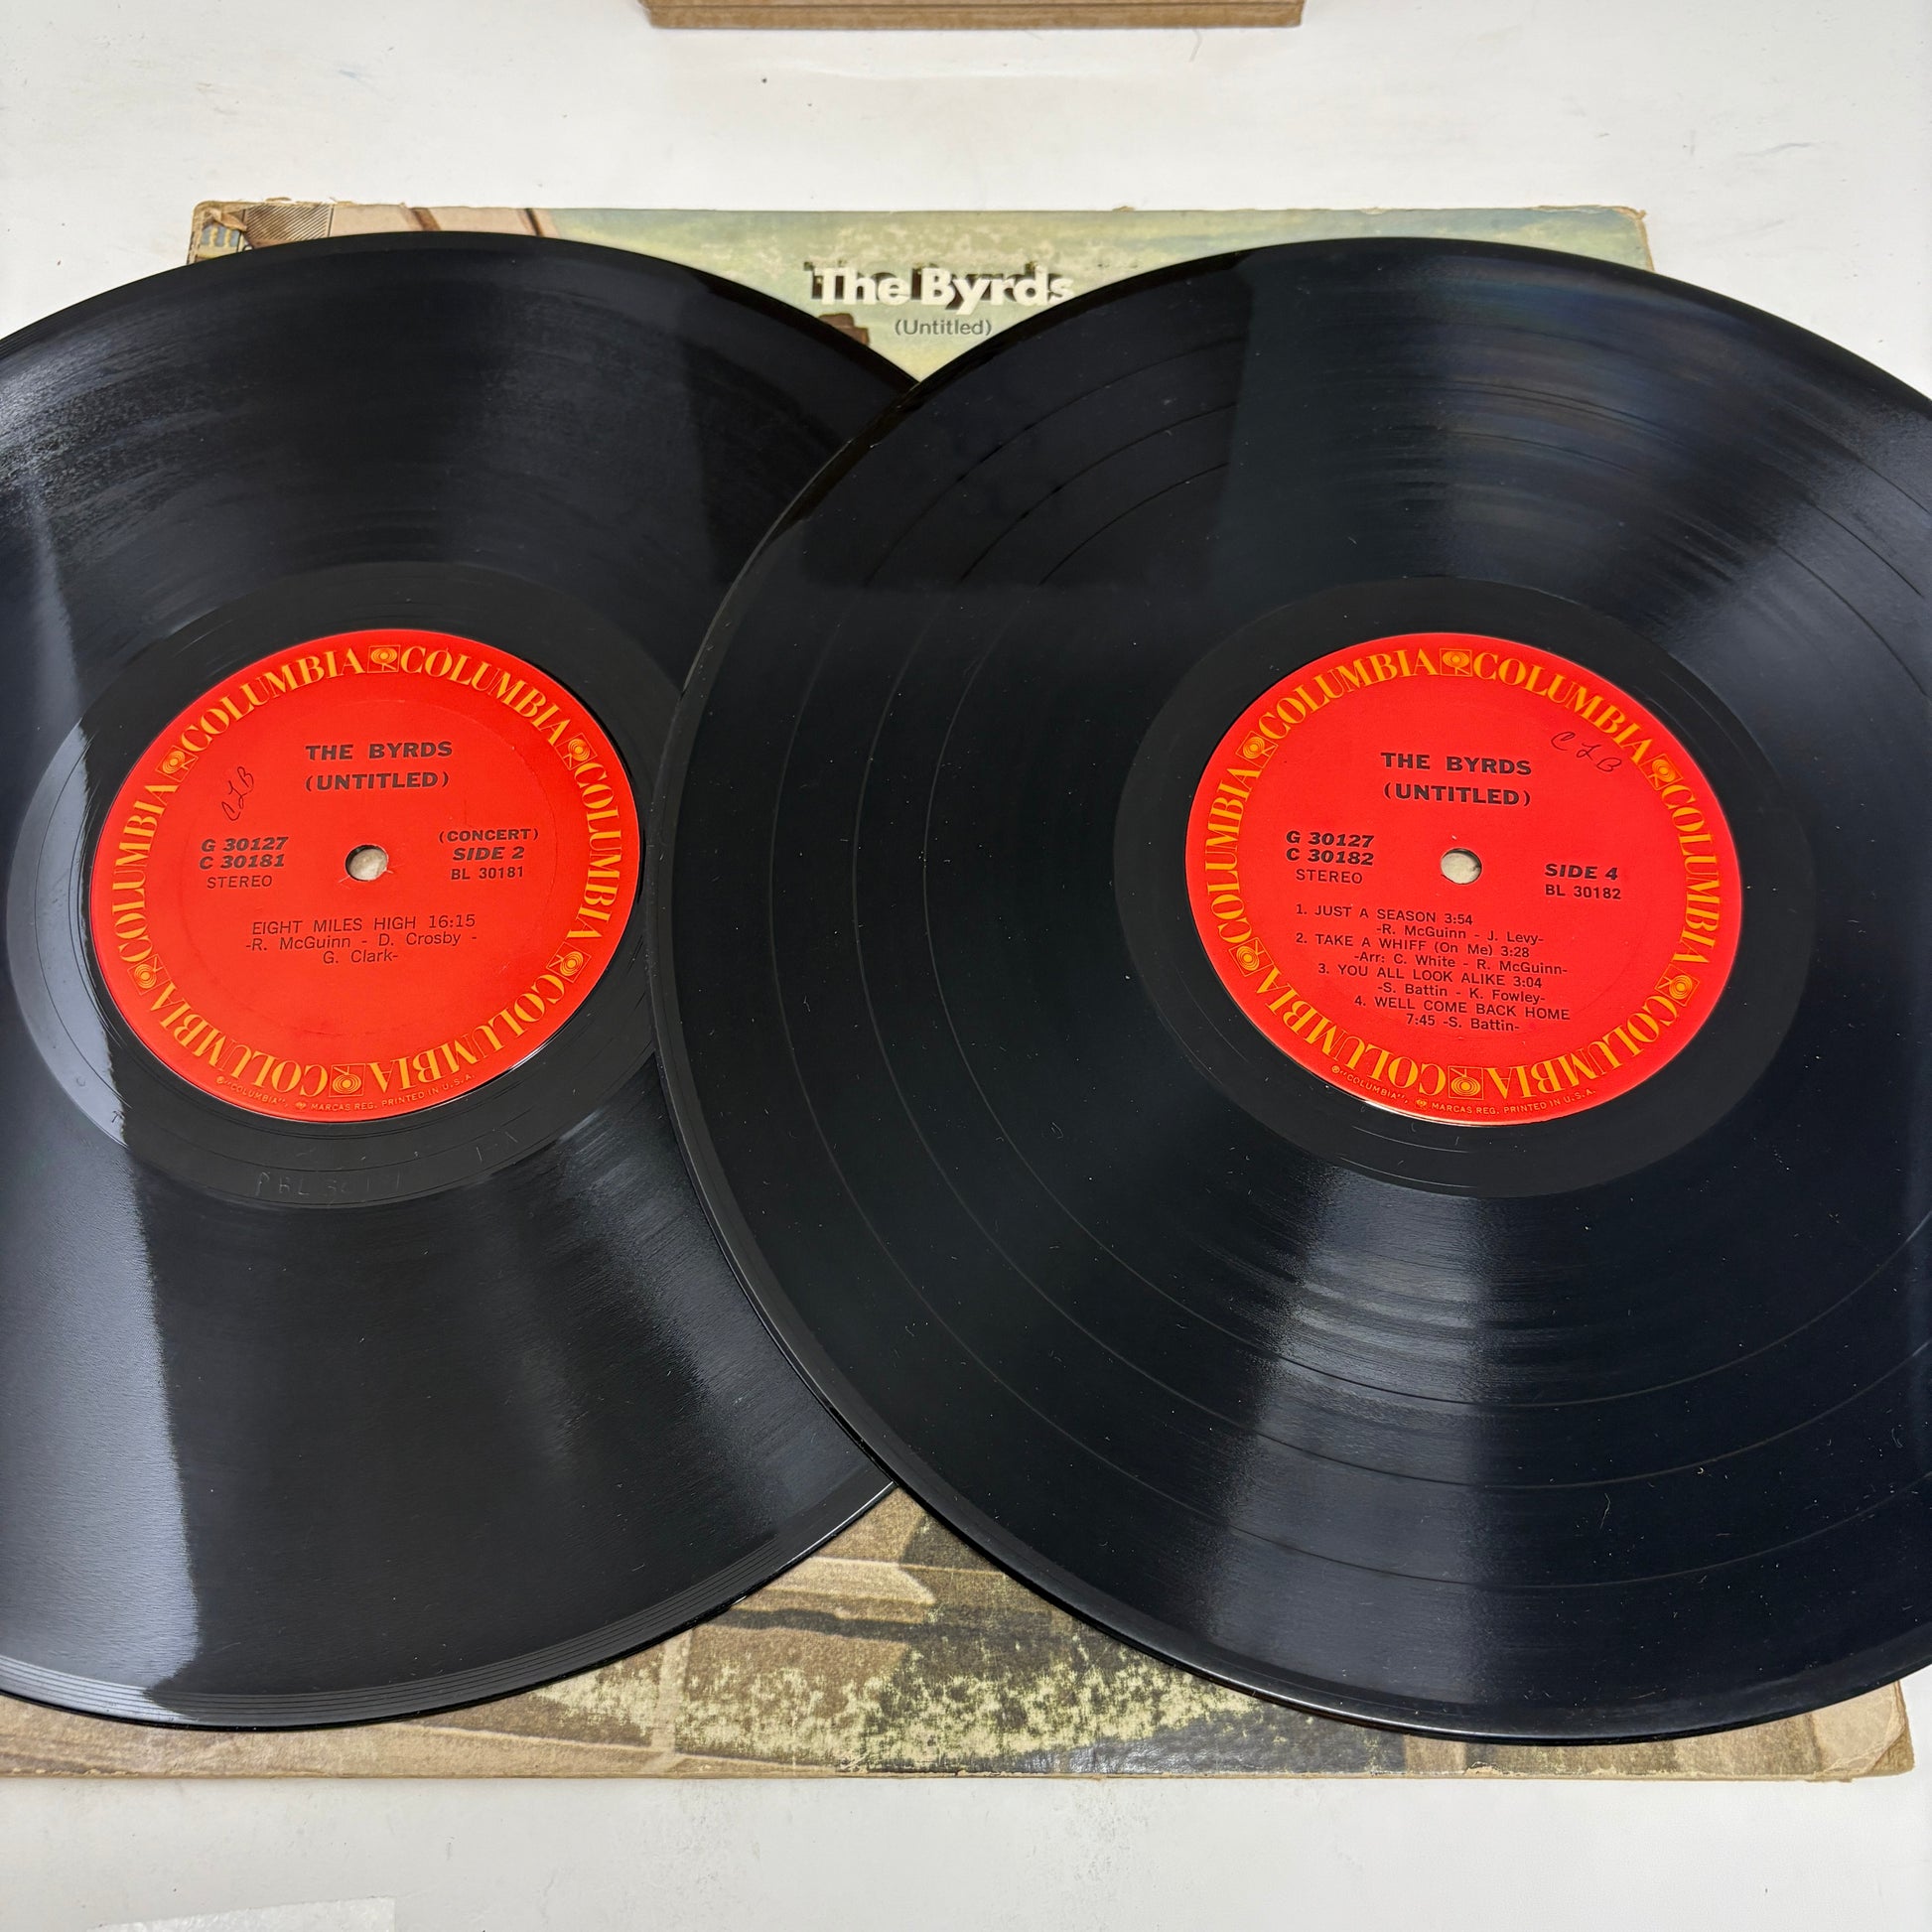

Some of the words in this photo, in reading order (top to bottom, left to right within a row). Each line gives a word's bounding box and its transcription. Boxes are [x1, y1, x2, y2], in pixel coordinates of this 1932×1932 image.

[812, 264, 910, 306] The
[919, 263, 1075, 316] Byrds
[895, 319, 992, 337] (Untitled)
[181, 647, 366, 753] COLUMBIA
[400, 646, 574, 747] COLUMBIA
[1258, 648, 1440, 740] COLUMBIA
[1472, 652, 1656, 763] COLUMBIA
[305, 745, 353, 761] THE
[368, 741, 453, 759] BYRDS
[1380, 752, 1431, 770] THE
[1446, 756, 1532, 775] BYRDS
[305, 771, 450, 791] (UNTITLED)
[1384, 782, 1531, 807] (UNTITLED)
[201, 838, 216, 852] G
[222, 836, 289, 852] 30127
[438, 828, 539, 843] (CONCERT)
[1286, 830, 1301, 844] G
[1308, 832, 1375, 848] 30127
[199, 856, 213, 870] C
[220, 853, 285, 869] 30181
[453, 847, 505, 861] SIDE
[511, 846, 525, 860] 2
[567, 762, 621, 938] COLUMBIA
[1205, 767, 1262, 944] COLUMBIA
[1286, 848, 1301, 862] C
[1308, 849, 1374, 866] 30182
[111, 784, 178, 963] COLUMBIA
[207, 875, 273, 890] STEREO
[451, 867, 471, 881] BL
[479, 866, 524, 880] 30181
[1296, 869, 1363, 885] STEREO
[1545, 863, 1597, 880] SIDE
[1604, 867, 1618, 881] 4
[1661, 784, 1721, 963] COLUMBIA
[1545, 884, 1566, 897] BL
[1574, 886, 1621, 900] 30182
[252, 920, 303, 935] EIGHT
[313, 918, 362, 933] MILES
[373, 916, 417, 930] HIGH
[428, 913, 476, 928] 16:15
[1296, 903, 1308, 915] 1.
[1314, 905, 1352, 917] JUST
[1359, 908, 1369, 918] A
[1376, 908, 1437, 923] SEASON
[1444, 913, 1473, 925] 3:54
[245, 938, 268, 951] -R.
[279, 934, 350, 950] McGuinn
[378, 933, 394, 946] D.
[405, 931, 462, 946] Crosby
[1296, 933, 1308, 944] 2.
[1315, 933, 1353, 947] TAKE
[1361, 937, 1371, 948] A
[1379, 938, 1427, 951] WHIFF
[1434, 941, 1458, 955] (On
[1467, 943, 1493, 957] Me)
[1500, 946, 1530, 958] 3:28
[1376, 923, 1395, 935] -R.
[1404, 925, 1466, 939] McGuinn
[1487, 930, 1498, 942] J.
[1506, 931, 1544, 946] Levy-
[323, 951, 339, 964] G.
[350, 948, 398, 963] Clark-
[1393, 953, 1407, 965] C.
[1415, 954, 1455, 968] White
[1476, 958, 1490, 970] R.
[1499, 961, 1568, 975] McGuinn-
[1317, 963, 1329, 975] 3.
[1338, 964, 1368, 977] YOU
[1376, 967, 1405, 980] ALL
[1413, 969, 1453, 983] LOOK
[1460, 972, 1505, 986] ALIKE
[1512, 976, 1543, 989] 3:04
[1377, 982, 1397, 994] -S.
[1405, 983, 1448, 997] Battin
[1469, 988, 1484, 1000] K.
[1492, 989, 1546, 1005] Fowley-
[1354, 995, 1366, 1007] 4.
[1374, 997, 1416, 1010] WELL
[1423, 1000, 1467, 1014] COME
[1476, 1004, 1517, 1018] BACK
[1525, 1007, 1571, 1021] HOME
[366, 974, 566, 1093] COLUMBIA
[1257, 961, 1447, 1096] COLUMBIA
[1406, 1013, 1436, 1027] 7:45
[1443, 1017, 1462, 1029] -S.
[1470, 1019, 1520, 1032] Battin-
[150, 981, 329, 1097] COLUMBIA
[1484, 996, 1678, 1099] COLUMBIA
[311, 1103, 350, 1112] MARCAS
[381, 1091, 425, 1107] PRINTED
[428, 1087, 439, 1096] IN
[442, 1073, 476, 1090] U.S.A.
[1431, 1102, 1472, 1113] MARCAS
[1476, 1106, 1500, 1115] REG.
[1503, 1101, 1547, 1113] PRINTED
[1550, 1098, 1561, 1107] IN
[1564, 1088, 1596, 1103] U.S.A.
